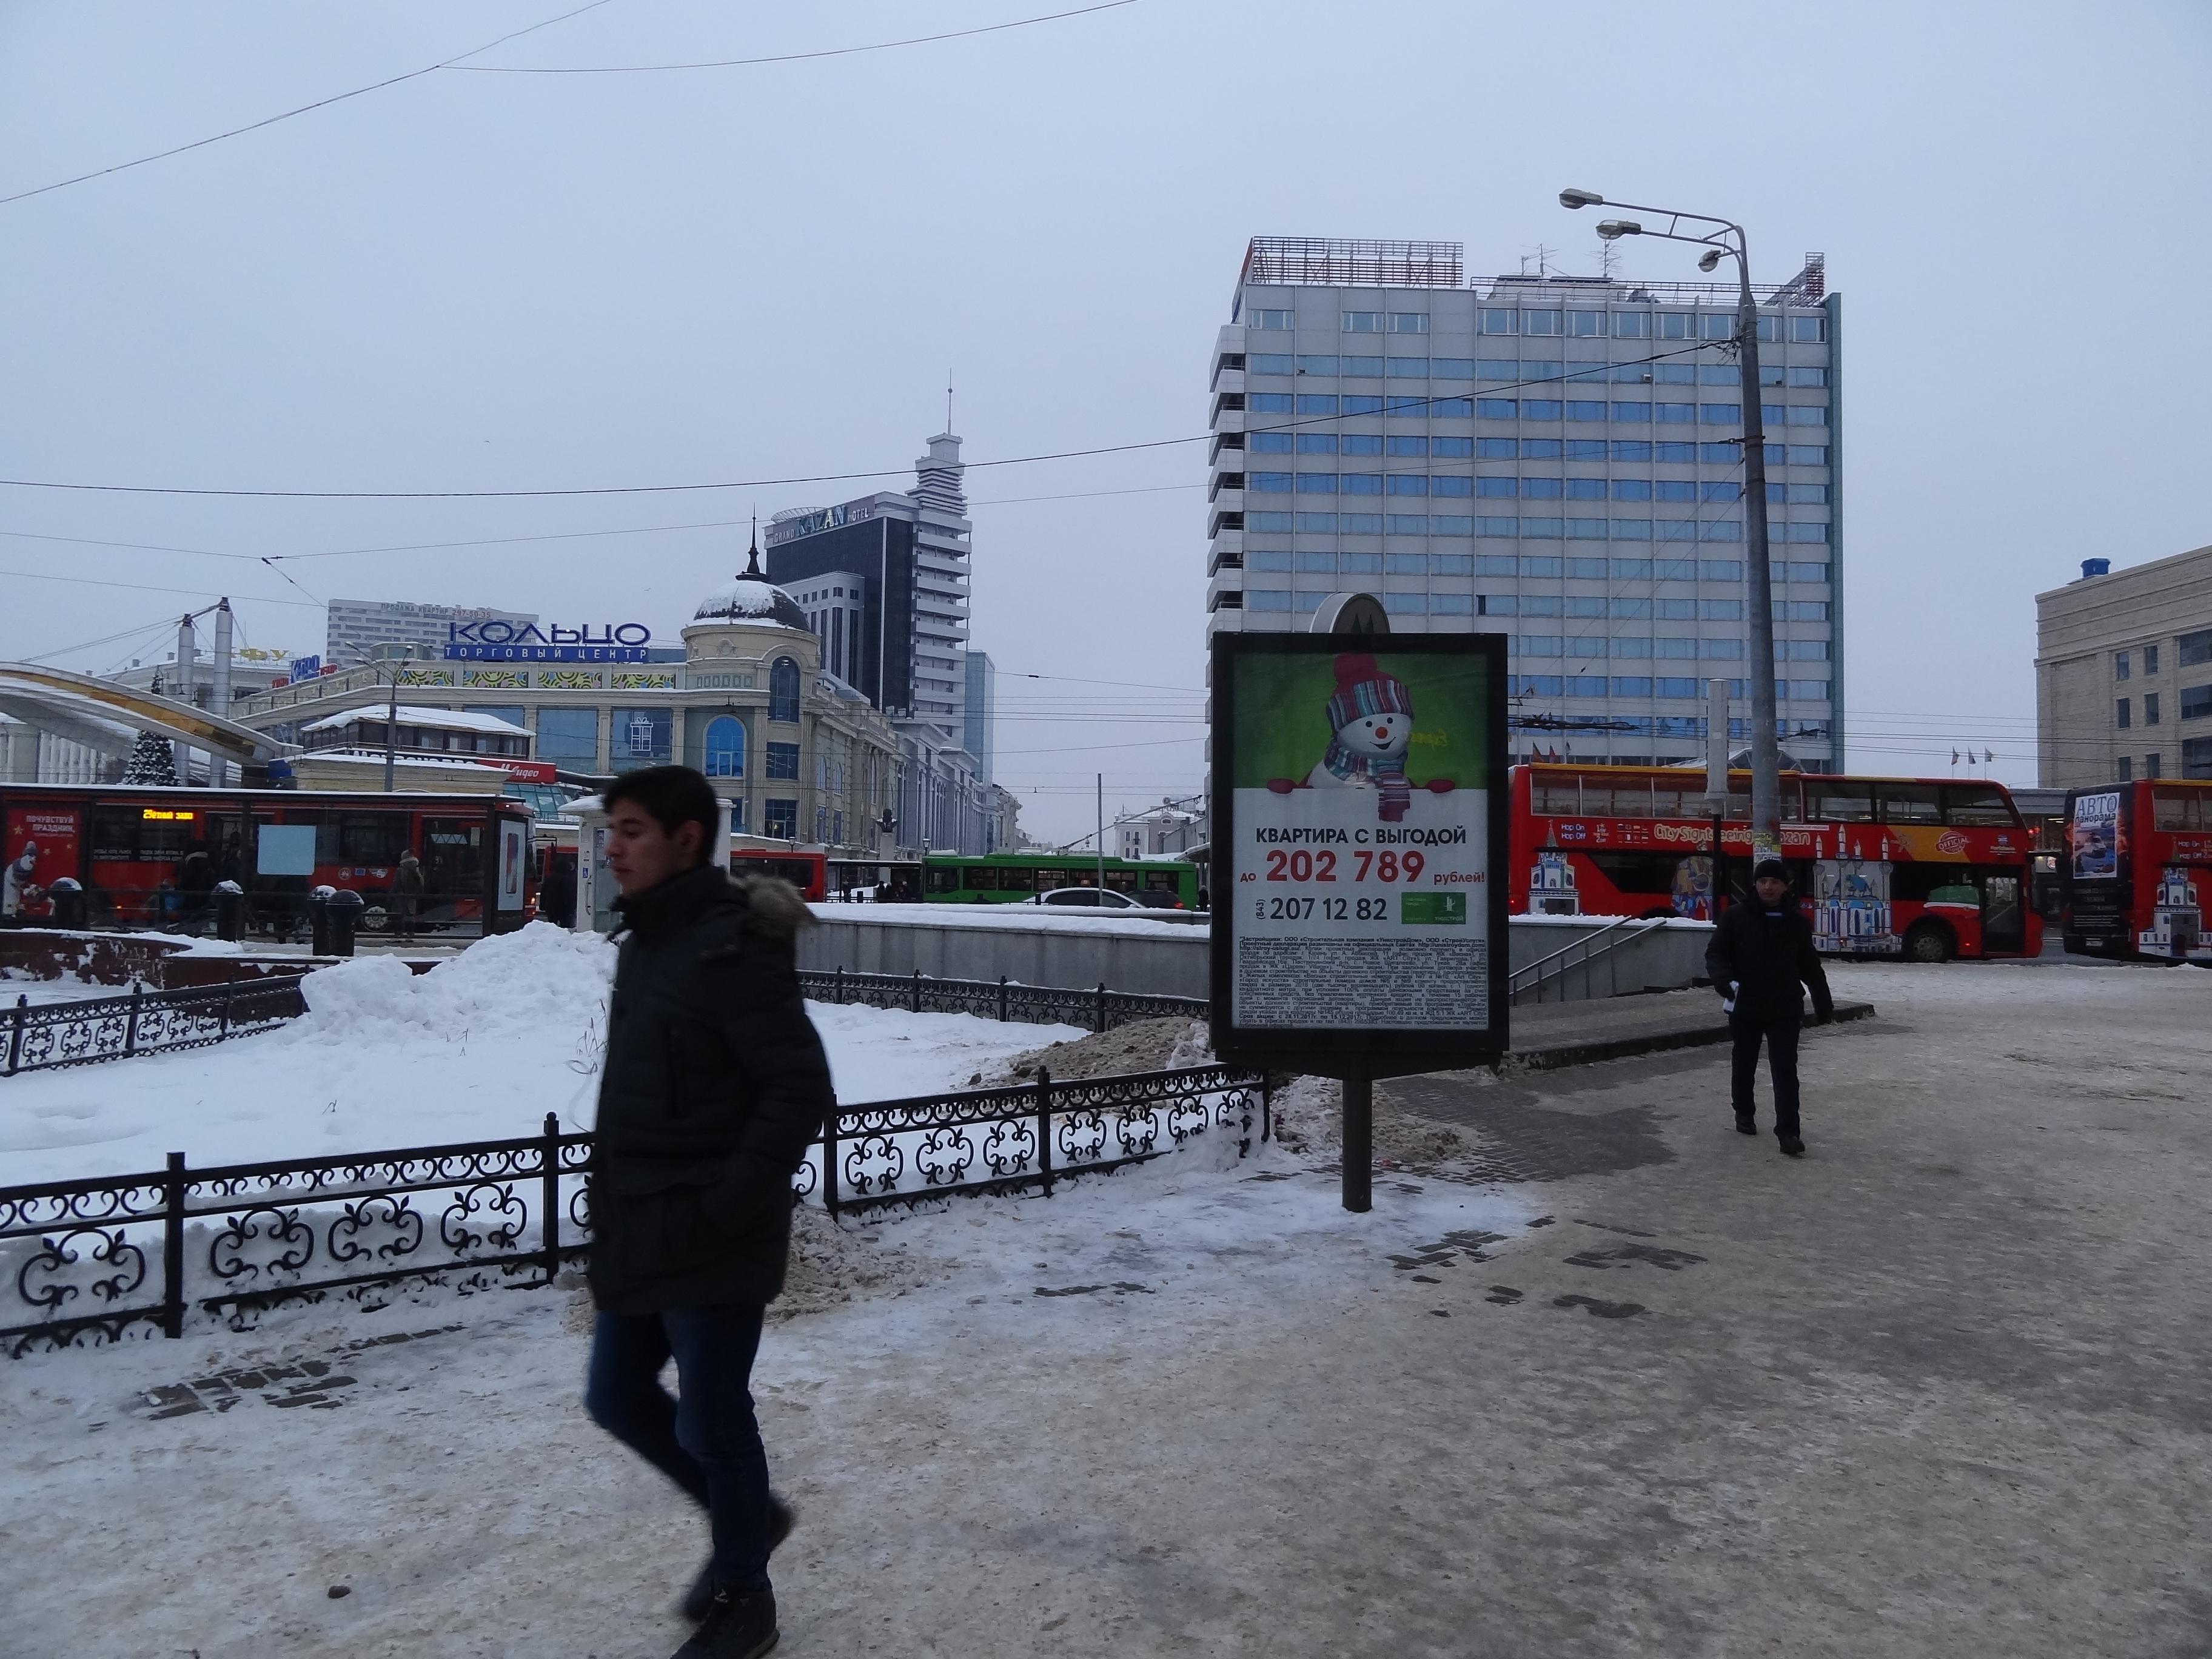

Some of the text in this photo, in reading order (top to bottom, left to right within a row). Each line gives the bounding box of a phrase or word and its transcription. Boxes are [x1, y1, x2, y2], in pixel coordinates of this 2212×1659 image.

[796, 504, 846, 537] KAZAN
[848, 507, 869, 523] HOTEL
[449, 621, 652, 646] КОЛЬЦО
[446, 646, 647, 660] ТОРГОВЫЙ ЦЕНТР
[2076, 795, 2118, 817] АВТО
[26, 815, 74, 823] ПОЧУВСТВУЙ
[2075, 813, 2116, 824] панорама
[1256, 825, 1467, 846] КВАРТИРА С ВЫГОДОЙ
[1679, 825, 1754, 845] Sighteeing
[1779, 831, 1811, 845] azan
[1240, 850, 1486, 886] до 202 789 рублей!
[1256, 897, 1387, 921] (843) 207 12 82
